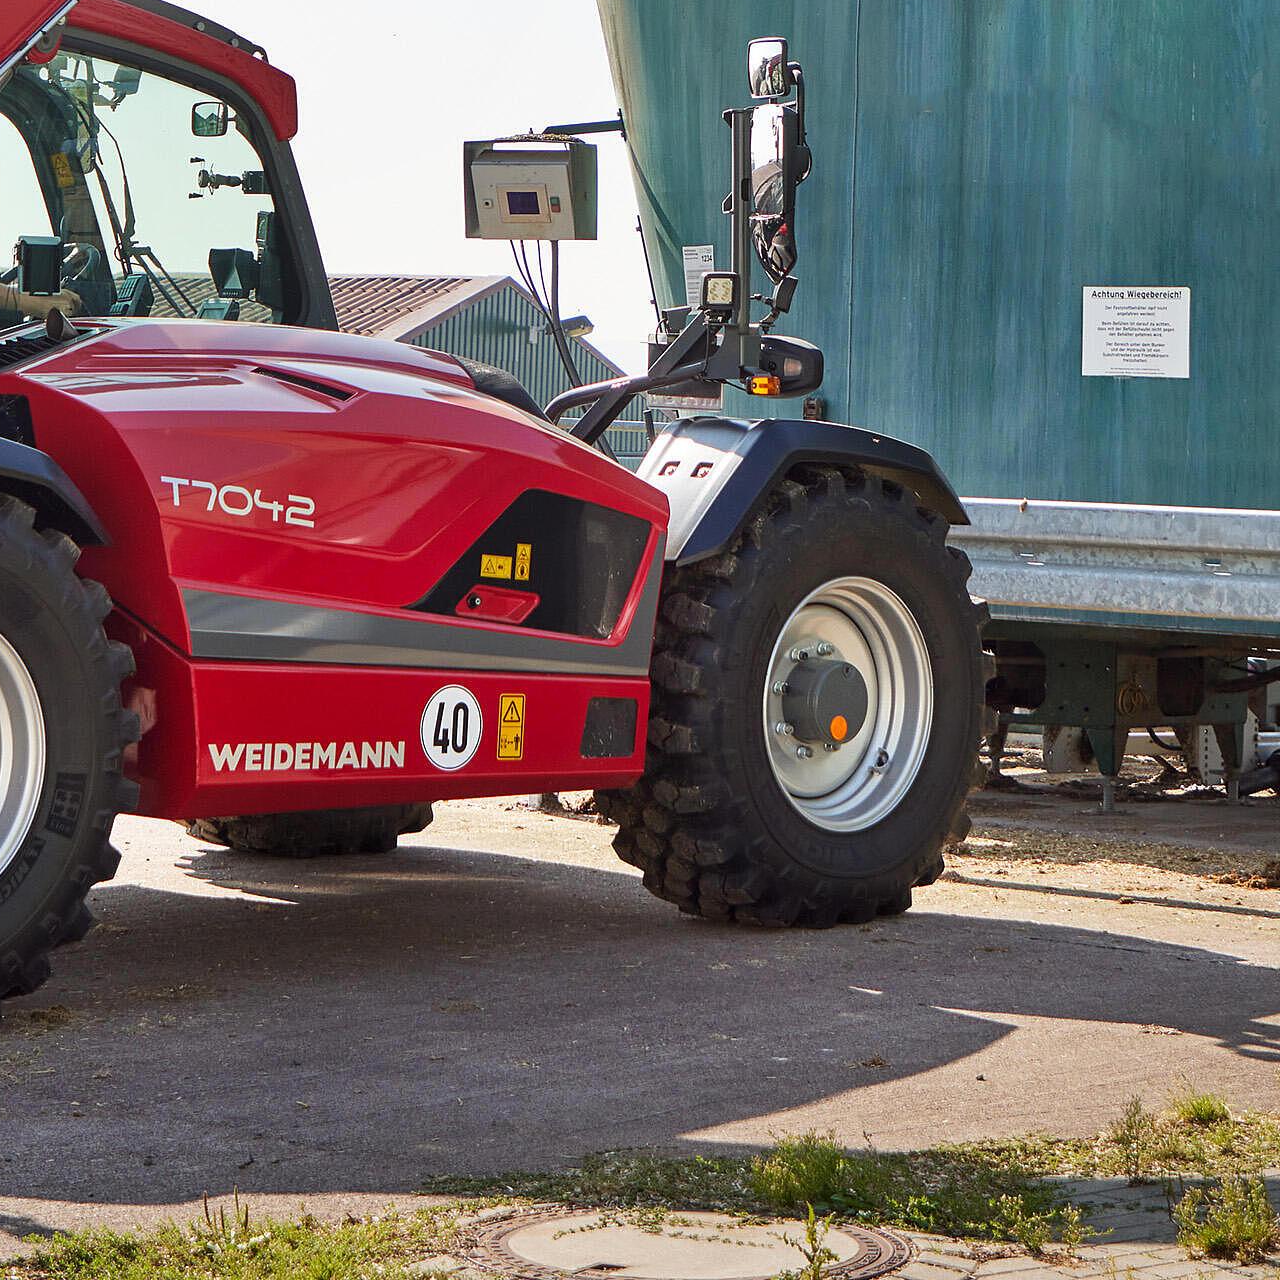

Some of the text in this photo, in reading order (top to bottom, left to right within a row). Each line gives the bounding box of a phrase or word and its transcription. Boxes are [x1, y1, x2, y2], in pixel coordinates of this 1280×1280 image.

[1091, 290, 1182, 299] Achtung Wiegebereich!
[160, 475, 315, 528] T7042
[433, 701, 469, 753] 40
[208, 741, 405, 771] WEIDEMANN
